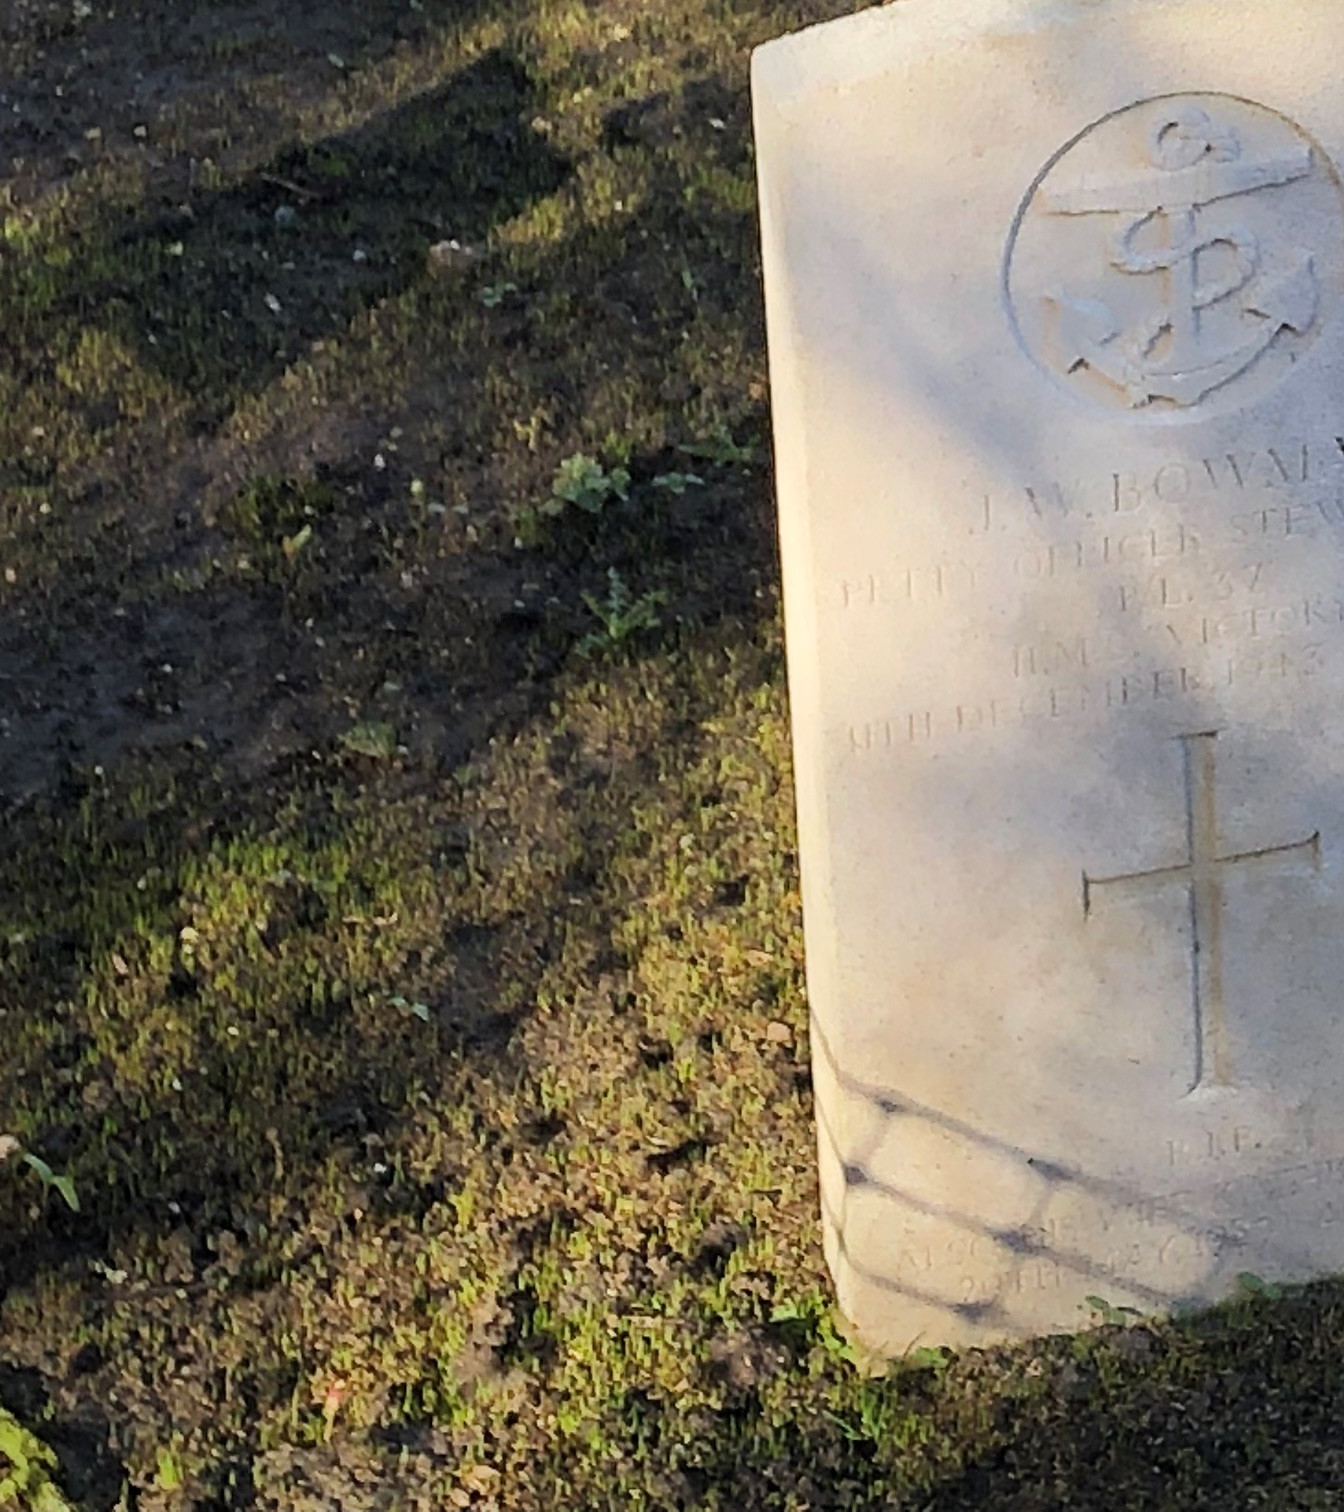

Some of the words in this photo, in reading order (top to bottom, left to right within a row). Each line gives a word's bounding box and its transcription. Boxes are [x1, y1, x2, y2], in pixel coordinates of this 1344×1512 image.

[839, 559, 981, 609] PETTY
[1012, 525, 1199, 584] OFFICER
[955, 667, 1206, 732] DECEMBER
